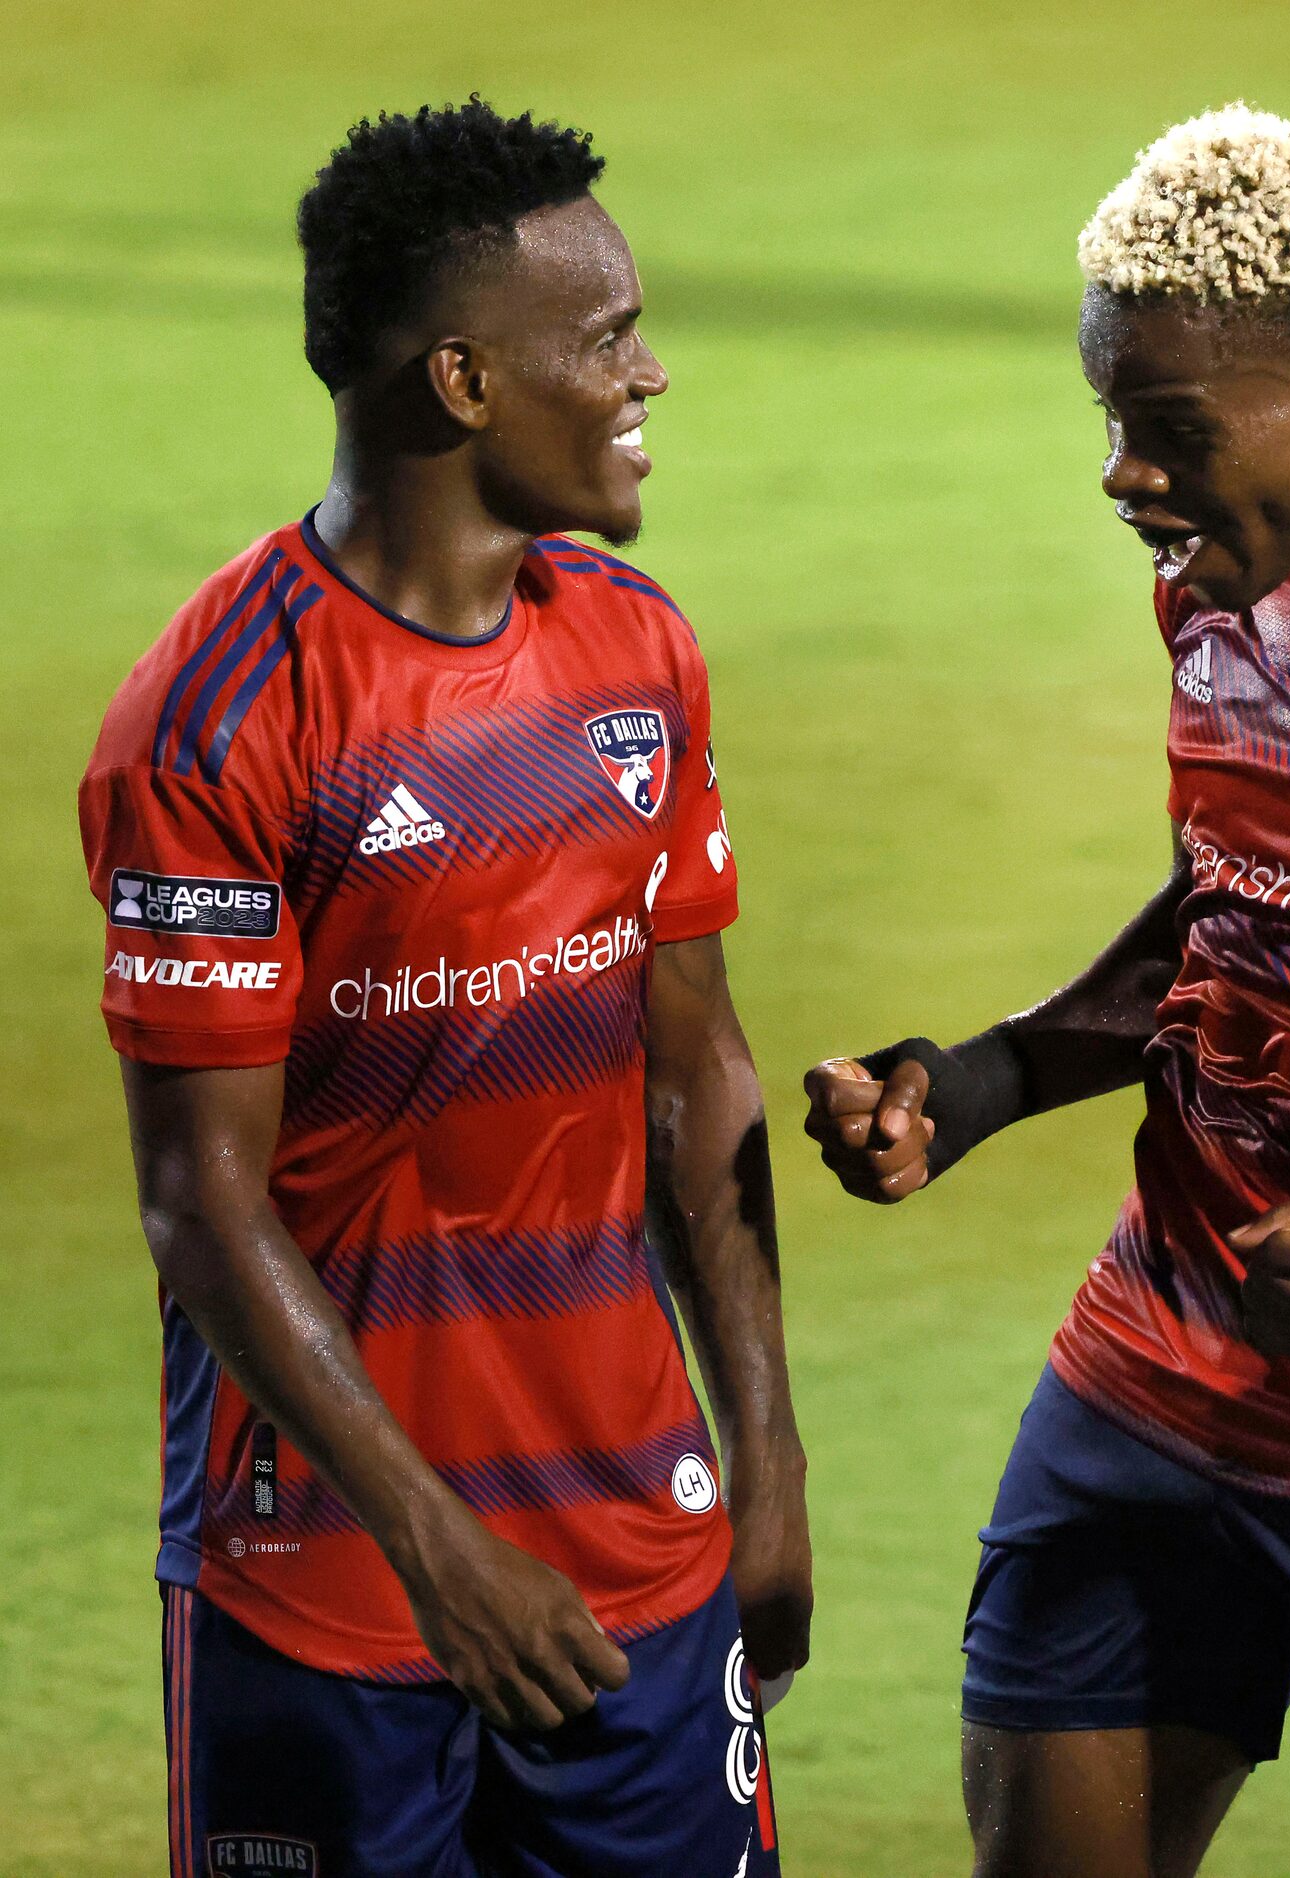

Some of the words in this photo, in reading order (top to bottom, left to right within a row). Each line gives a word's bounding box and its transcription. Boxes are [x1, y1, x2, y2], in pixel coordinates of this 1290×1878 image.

[1177, 670, 1213, 704] adidas
[591, 722, 612, 748] FC
[610, 716, 659, 742] DALLAS
[359, 821, 446, 855] adidas
[146, 882, 272, 910] LEAGUES
[146, 902, 198, 925] CUP
[197, 907, 270, 929] 2023
[105, 950, 282, 989] ADVOCARE
[680, 1469, 704, 1498] LH
[250, 1543, 301, 1553] AEROREADY
[216, 1841, 236, 1866] FC
[243, 1841, 307, 1870] DALLAS
